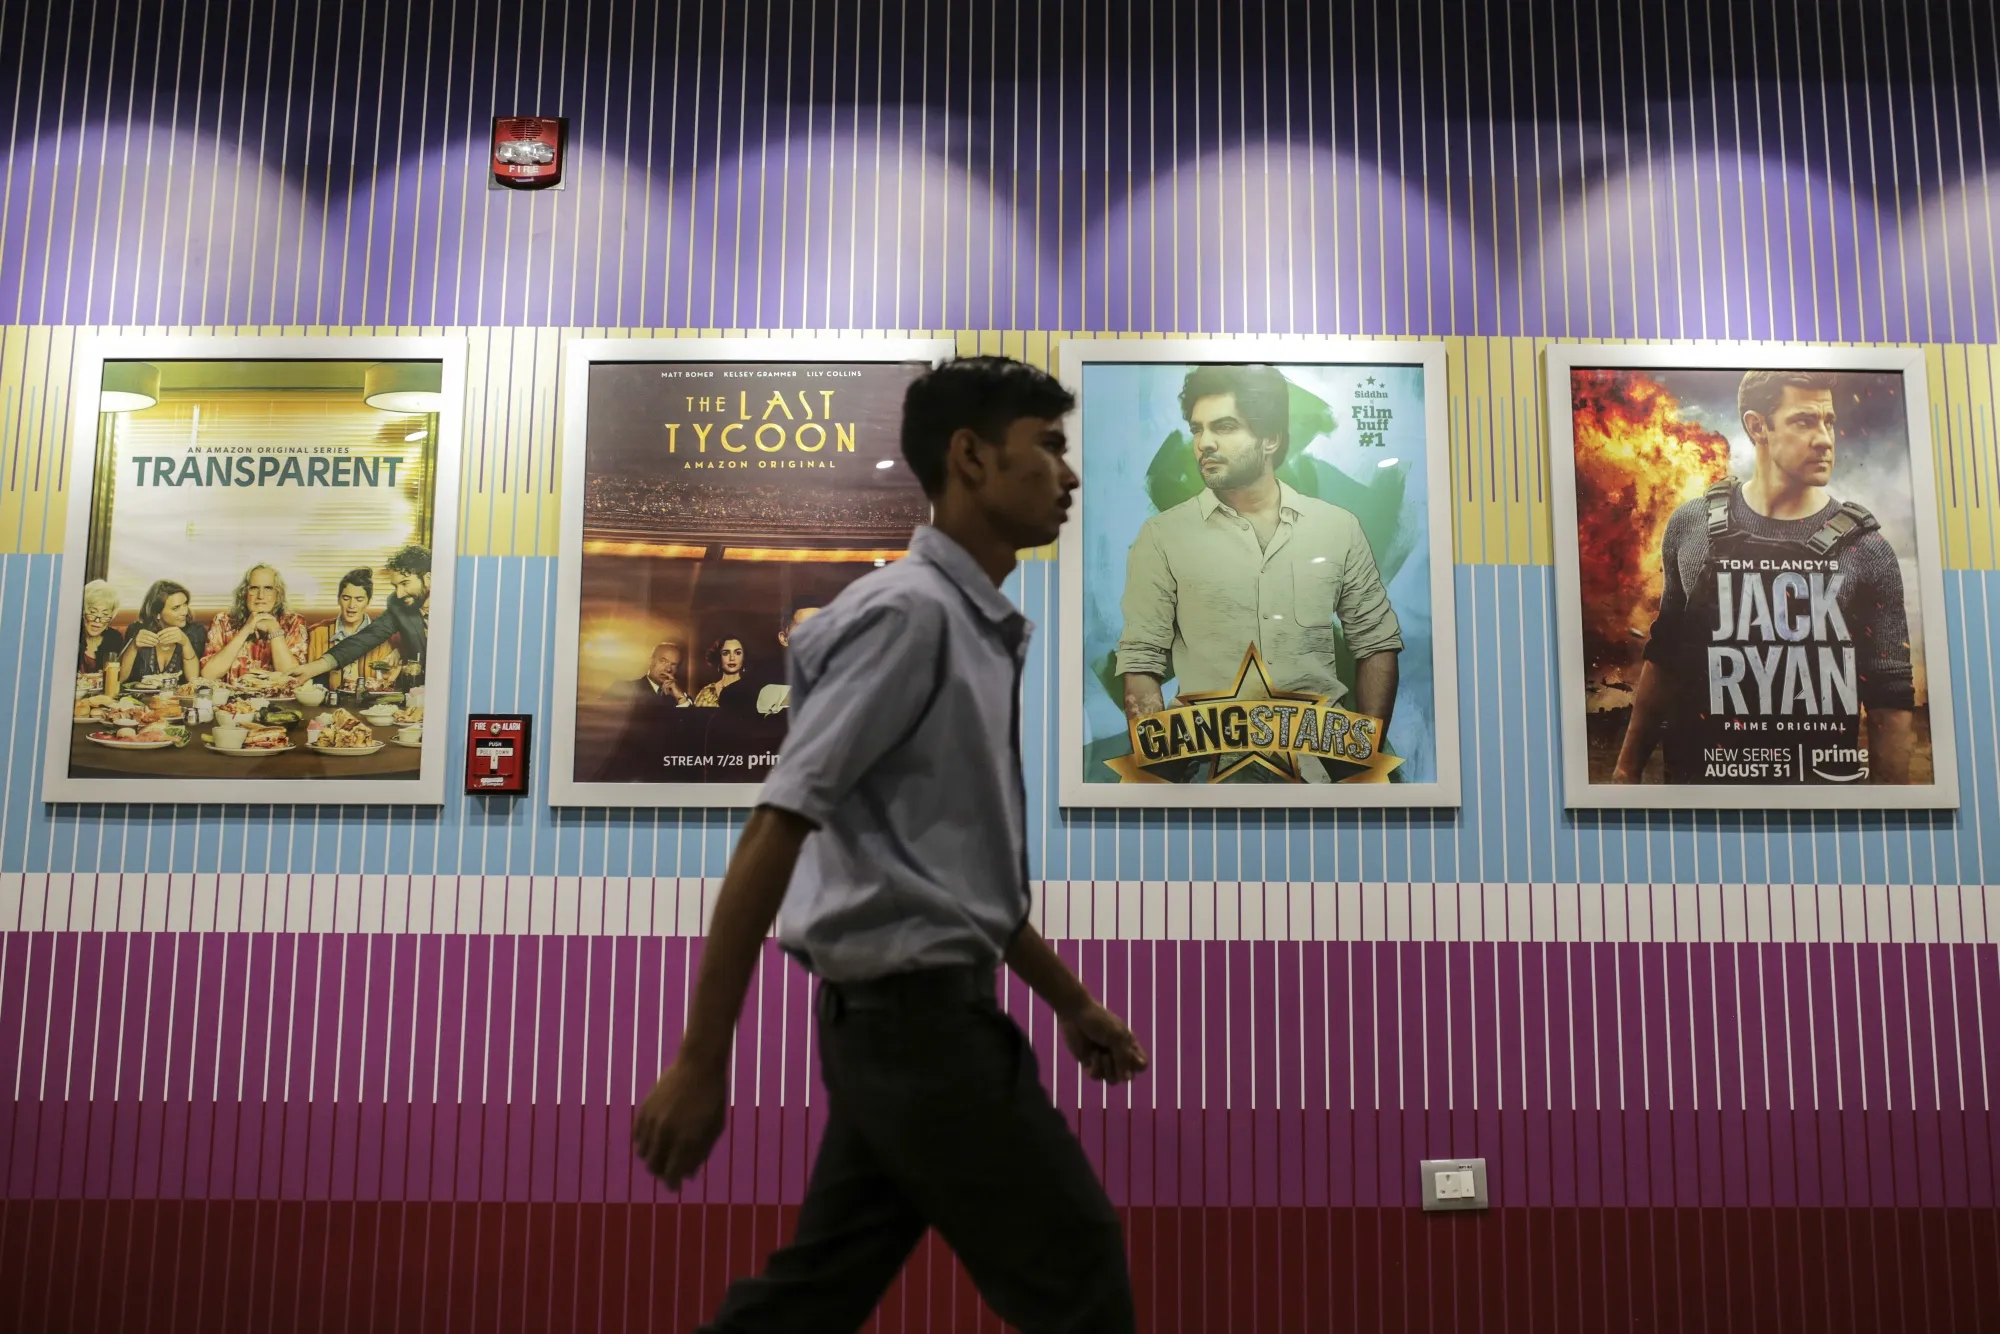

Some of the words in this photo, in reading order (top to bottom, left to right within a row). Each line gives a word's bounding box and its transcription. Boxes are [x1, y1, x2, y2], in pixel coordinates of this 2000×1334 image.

[509, 165, 539, 173] FIRE
[1354, 391, 1388, 399] Siddhu
[686, 396, 726, 412] THE
[740, 390, 835, 420] LAST
[1351, 406, 1393, 419] Film
[1356, 419, 1389, 431] buff
[664, 423, 855, 453] TYCOON
[1359, 432, 1386, 447] #1
[132, 456, 404, 487] TRANSPARENT
[684, 461, 748, 469] AMAZON
[758, 461, 836, 469] ORIGINAL
[1719, 560, 1754, 570] TOM
[1760, 560, 1839, 570] CLANCY'S
[1712, 571, 1852, 642] JACK
[1707, 645, 1859, 715] RYAN
[474, 722, 486, 730] FIRE
[502, 722, 521, 730] ALARM
[1136, 705, 1377, 761] GANGSTARS
[1724, 722, 1768, 731] PRIME
[1776, 722, 1846, 731] ORIGINAL
[663, 756, 713, 766] STREAM
[716, 755, 744, 767] 7/28
[1704, 748, 1738, 762] NEW
[1742, 748, 1791, 762] SERIES
[1812, 744, 1869, 767] prime
[1704, 763, 1769, 777] AUGUST
[1773, 763, 1790, 777] 31
